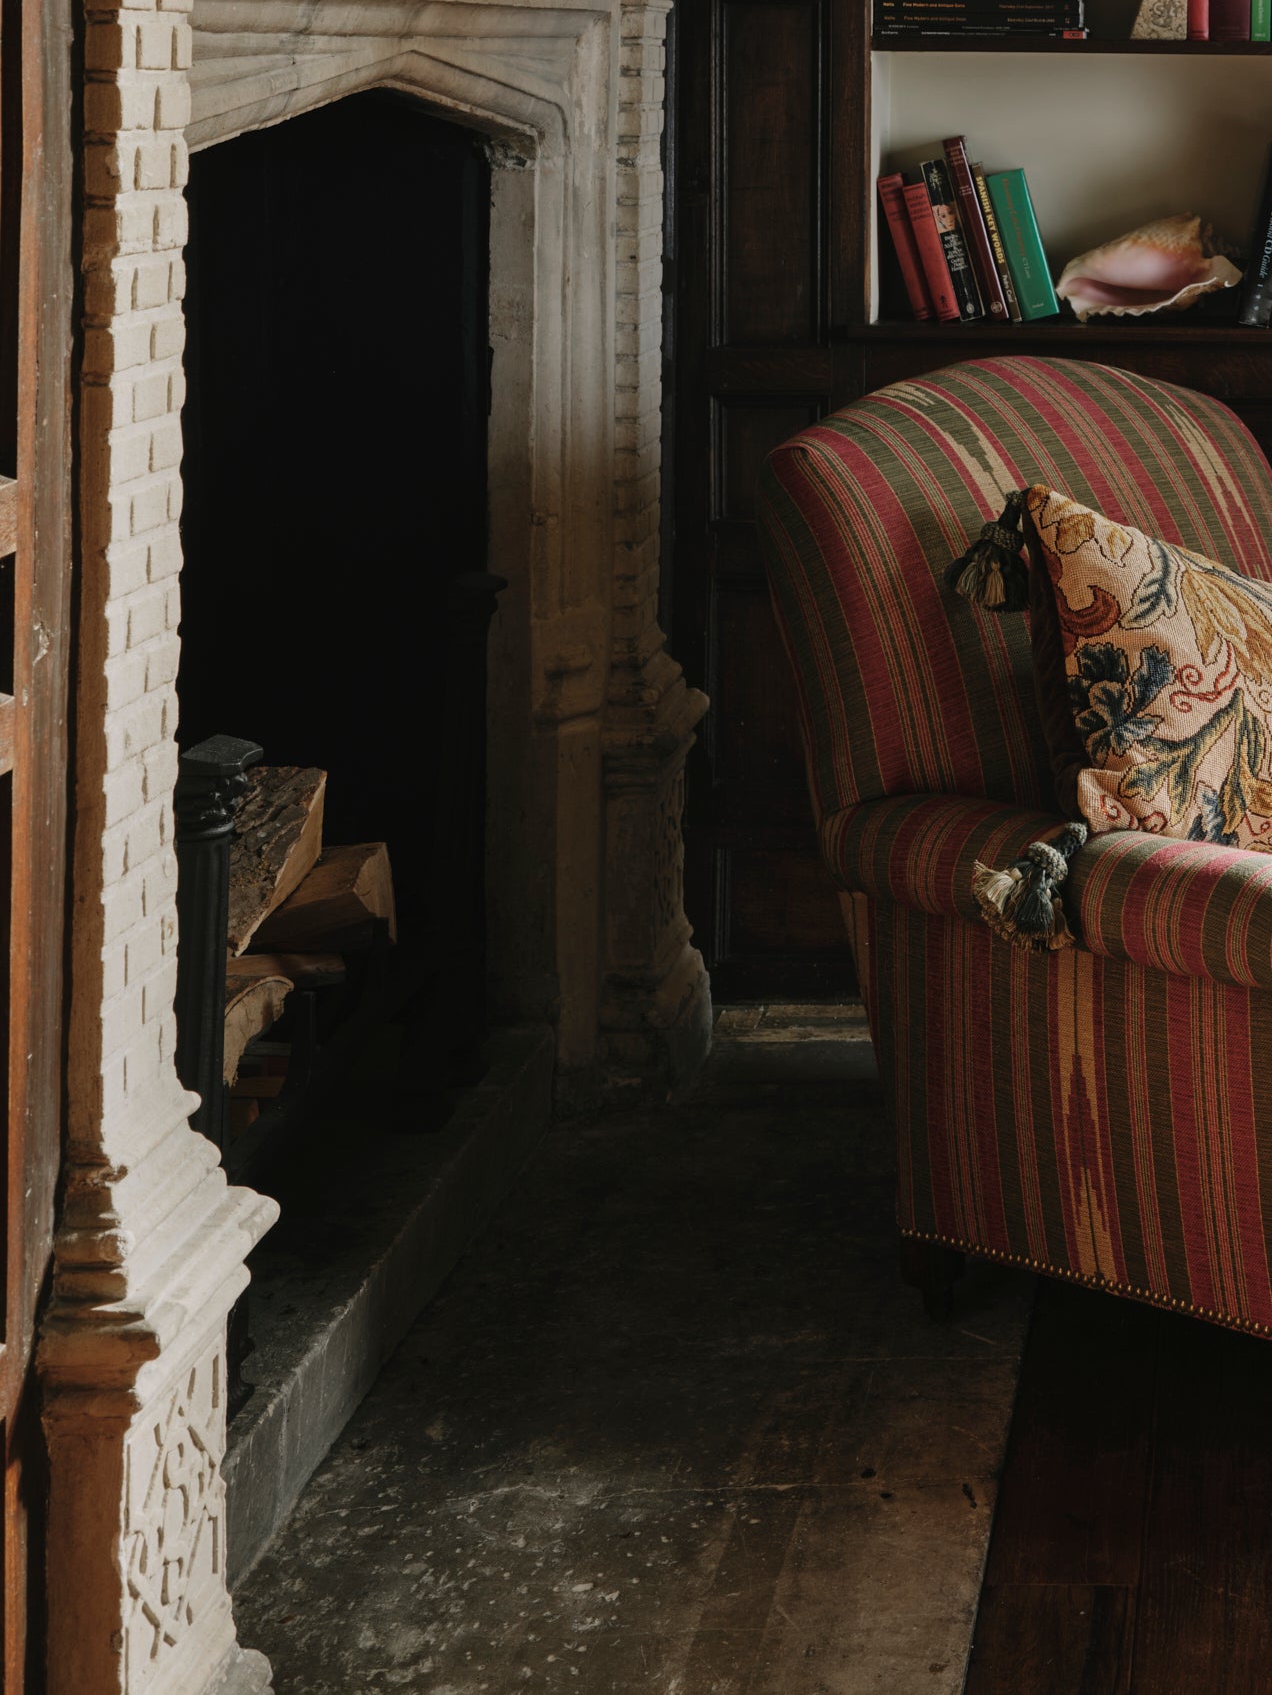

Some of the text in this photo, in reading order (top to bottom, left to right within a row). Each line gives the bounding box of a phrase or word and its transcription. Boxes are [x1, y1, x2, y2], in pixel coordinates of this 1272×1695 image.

[975, 176, 1005, 264] SPANISH KEY WORDS
[1259, 254, 1271, 278] Guide
